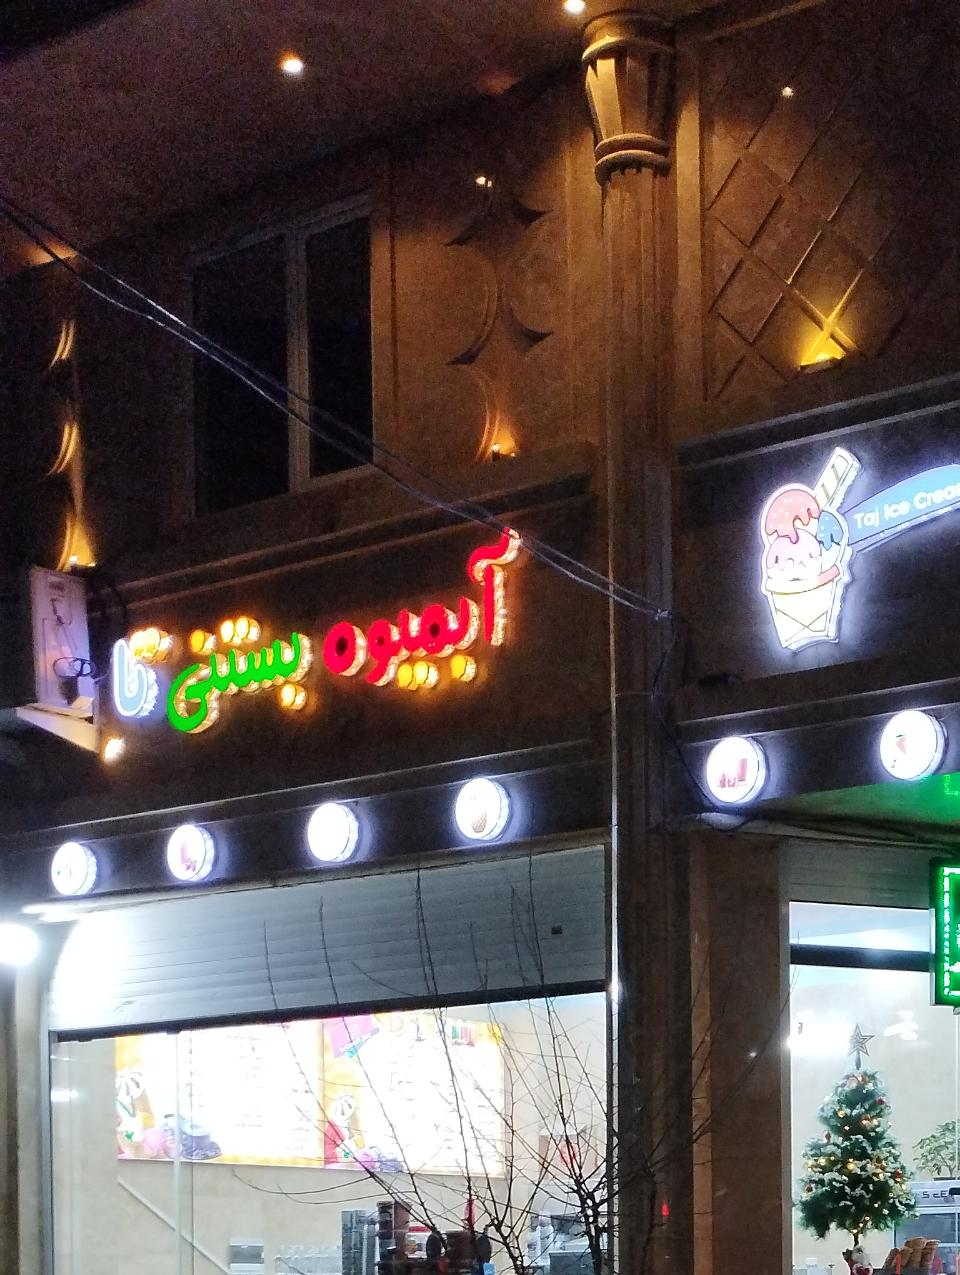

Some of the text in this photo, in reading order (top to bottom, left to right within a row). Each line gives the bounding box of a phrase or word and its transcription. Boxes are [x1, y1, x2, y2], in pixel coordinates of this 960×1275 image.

[854, 507, 880, 529] Taj
[884, 500, 910, 520] Ice
[322, 527, 521, 690] آبمیوه
[167, 617, 311, 733] بستنی
